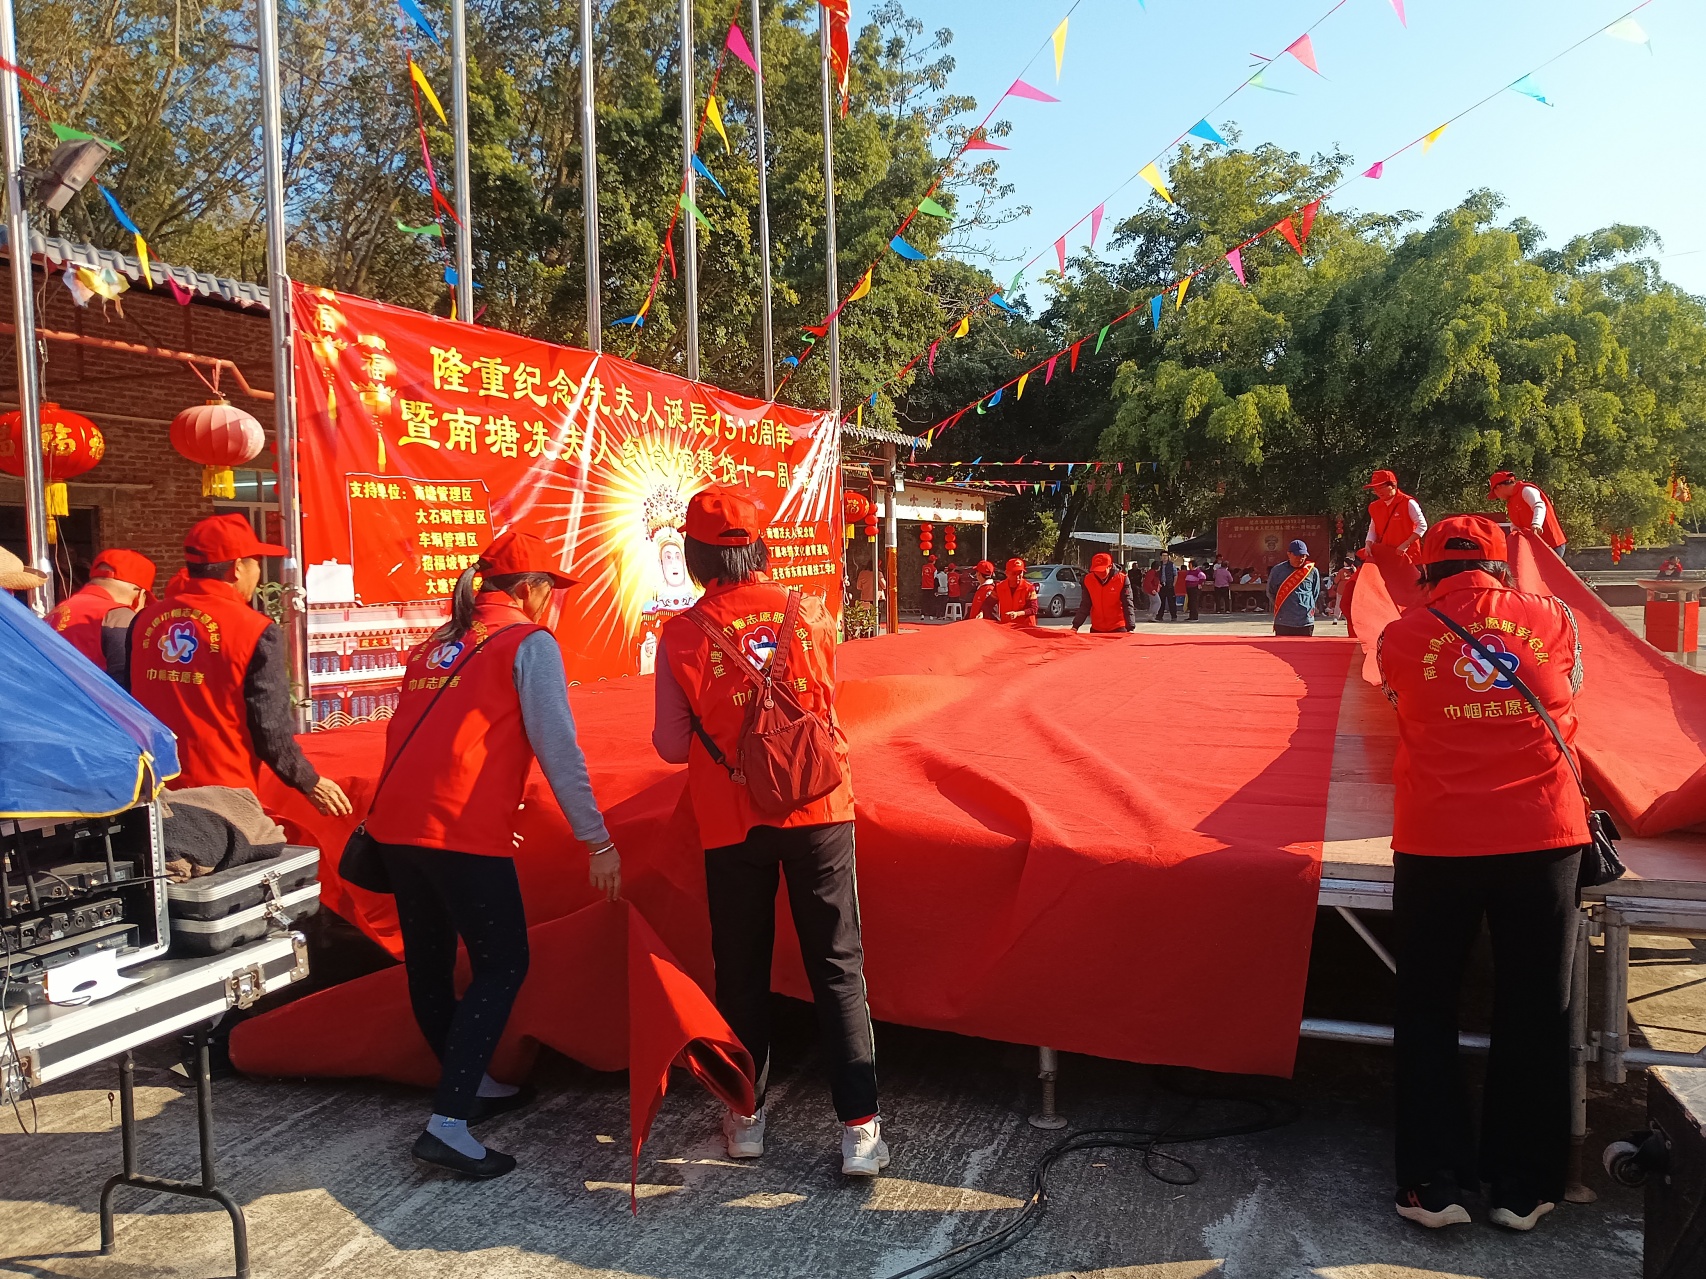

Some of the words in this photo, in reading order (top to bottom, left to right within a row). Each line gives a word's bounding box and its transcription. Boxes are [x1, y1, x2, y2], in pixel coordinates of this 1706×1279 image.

[350, 480, 407, 500] 支持单位：
[412, 484, 473, 502] 南塘管理区
[422, 554, 481, 572] 招福坡管理
[146, 667, 205, 685] 巾帼志愿者
